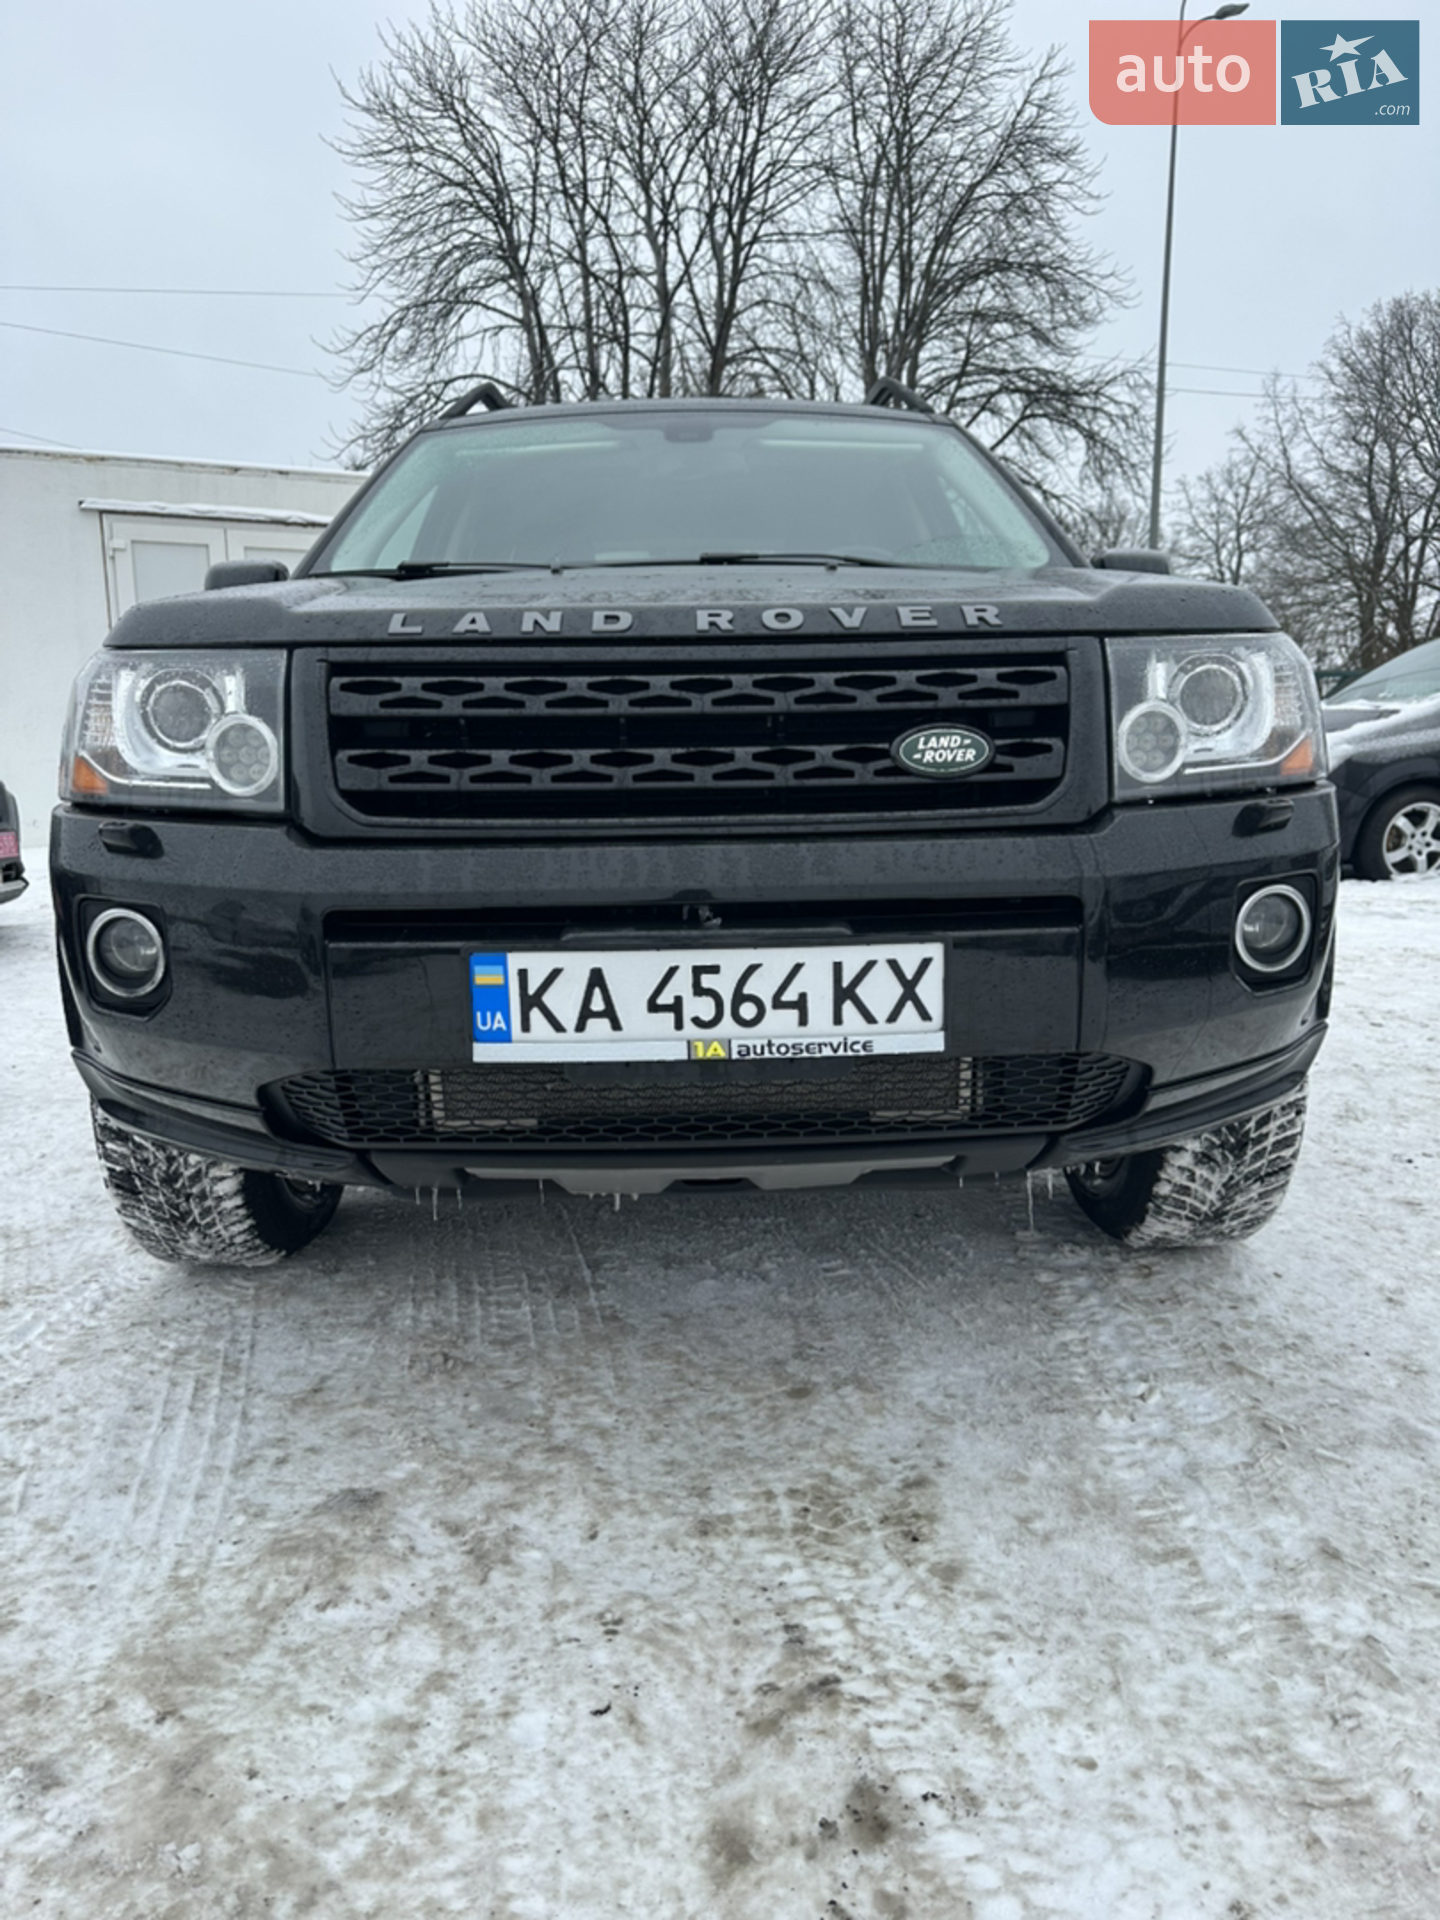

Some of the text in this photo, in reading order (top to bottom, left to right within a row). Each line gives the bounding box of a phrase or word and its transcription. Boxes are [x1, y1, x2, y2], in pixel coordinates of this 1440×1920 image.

[387, 604, 1004, 634] LAND ROVER
[516, 956, 934, 1034] KA 4564 KX
[475, 1010, 507, 1031] UA
[692, 1036, 875, 1058] 1A autoservice
